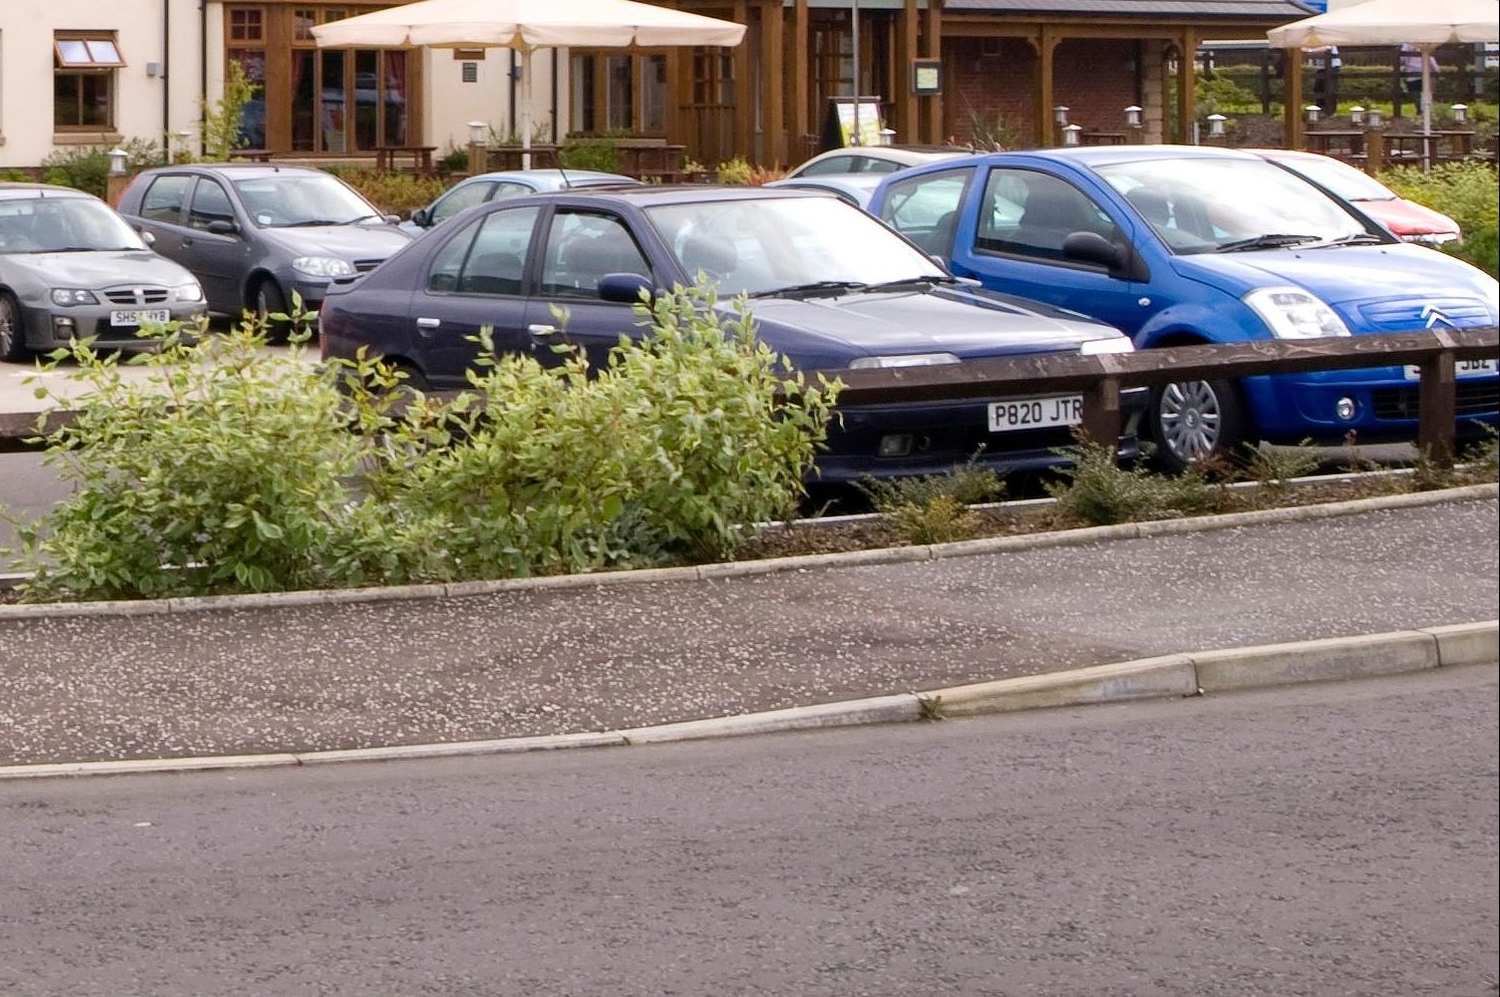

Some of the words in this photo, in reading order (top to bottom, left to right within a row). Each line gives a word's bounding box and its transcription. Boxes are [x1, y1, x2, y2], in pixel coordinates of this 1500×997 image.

[115, 311, 143, 323] SH5
[995, 402, 1042, 427] P820
[1050, 399, 1083, 421] JTR
